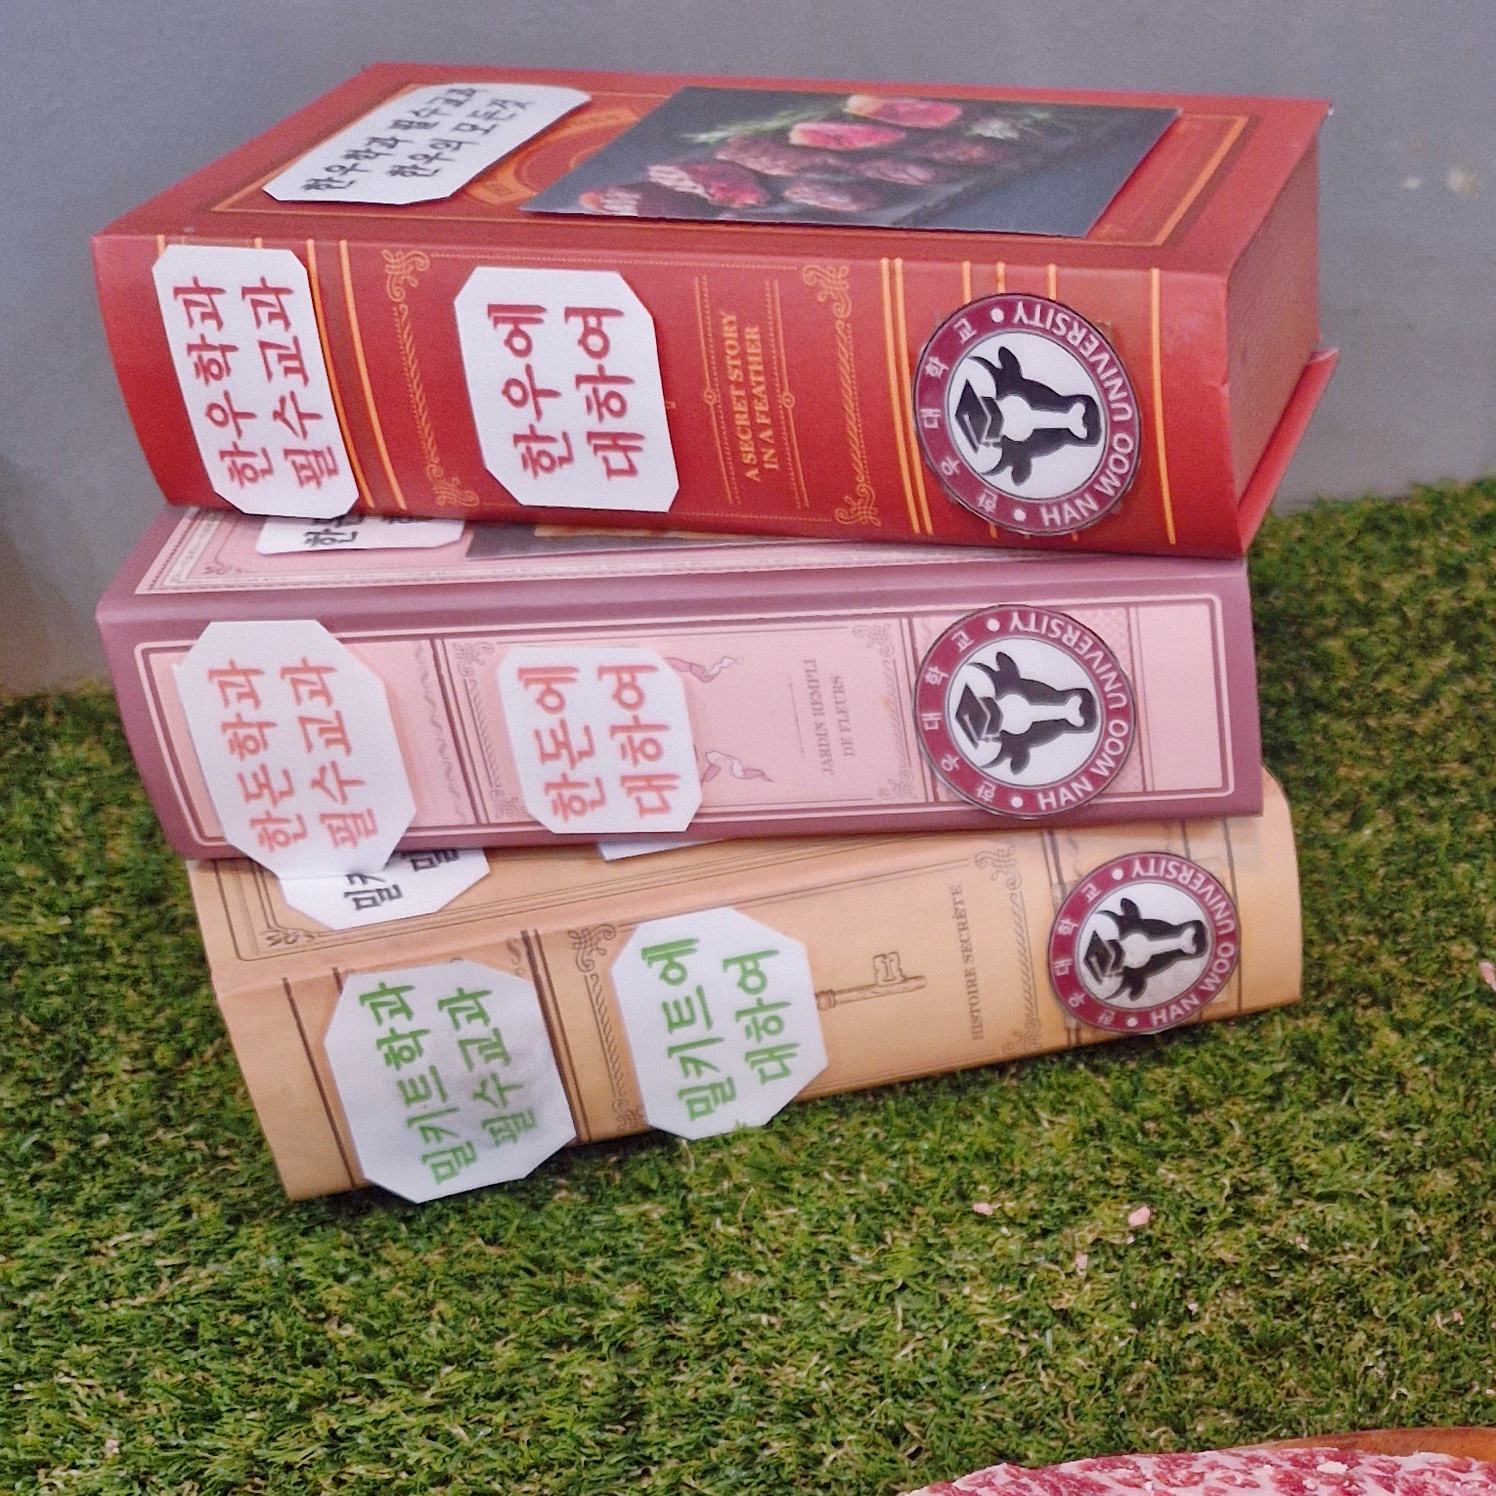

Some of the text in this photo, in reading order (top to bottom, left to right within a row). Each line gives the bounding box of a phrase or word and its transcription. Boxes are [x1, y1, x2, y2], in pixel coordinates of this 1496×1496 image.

[302, 87, 487, 191] 한우학과 필수교과
[387, 138, 478, 178] 한우의
[172, 276, 274, 490] 한우학과
[240, 276, 340, 490] 필수교과
[486, 303, 575, 480] 한우에
[564, 306, 647, 480] 대하여
[721, 311, 761, 483] A SECRET STORY
[744, 325, 780, 470] IN A FEATHER
[1012, 300, 1134, 528] HAN WOO UNIVERSITY
[208, 659, 308, 853] 한돈학과
[280, 656, 379, 850] 필수교과
[517, 665, 611, 824] 한돈에
[597, 665, 682, 821] 대하여
[804, 659, 835, 776] JARDIN REMPLI
[832, 675, 856, 756] DE FLEURS
[1009, 611, 1129, 811] HAN WOO UNIVERSITY
[722, 949, 801, 1086] 대하여
[964, 967, 985, 1042] HISTOIRE
[1131, 858, 1236, 1026] HAN WOO UNIVERSITY
[359, 982, 480, 1185] 밀키트학과
[437, 987, 537, 1149] 필수교과
[641, 937, 740, 1122] 밀키트에
